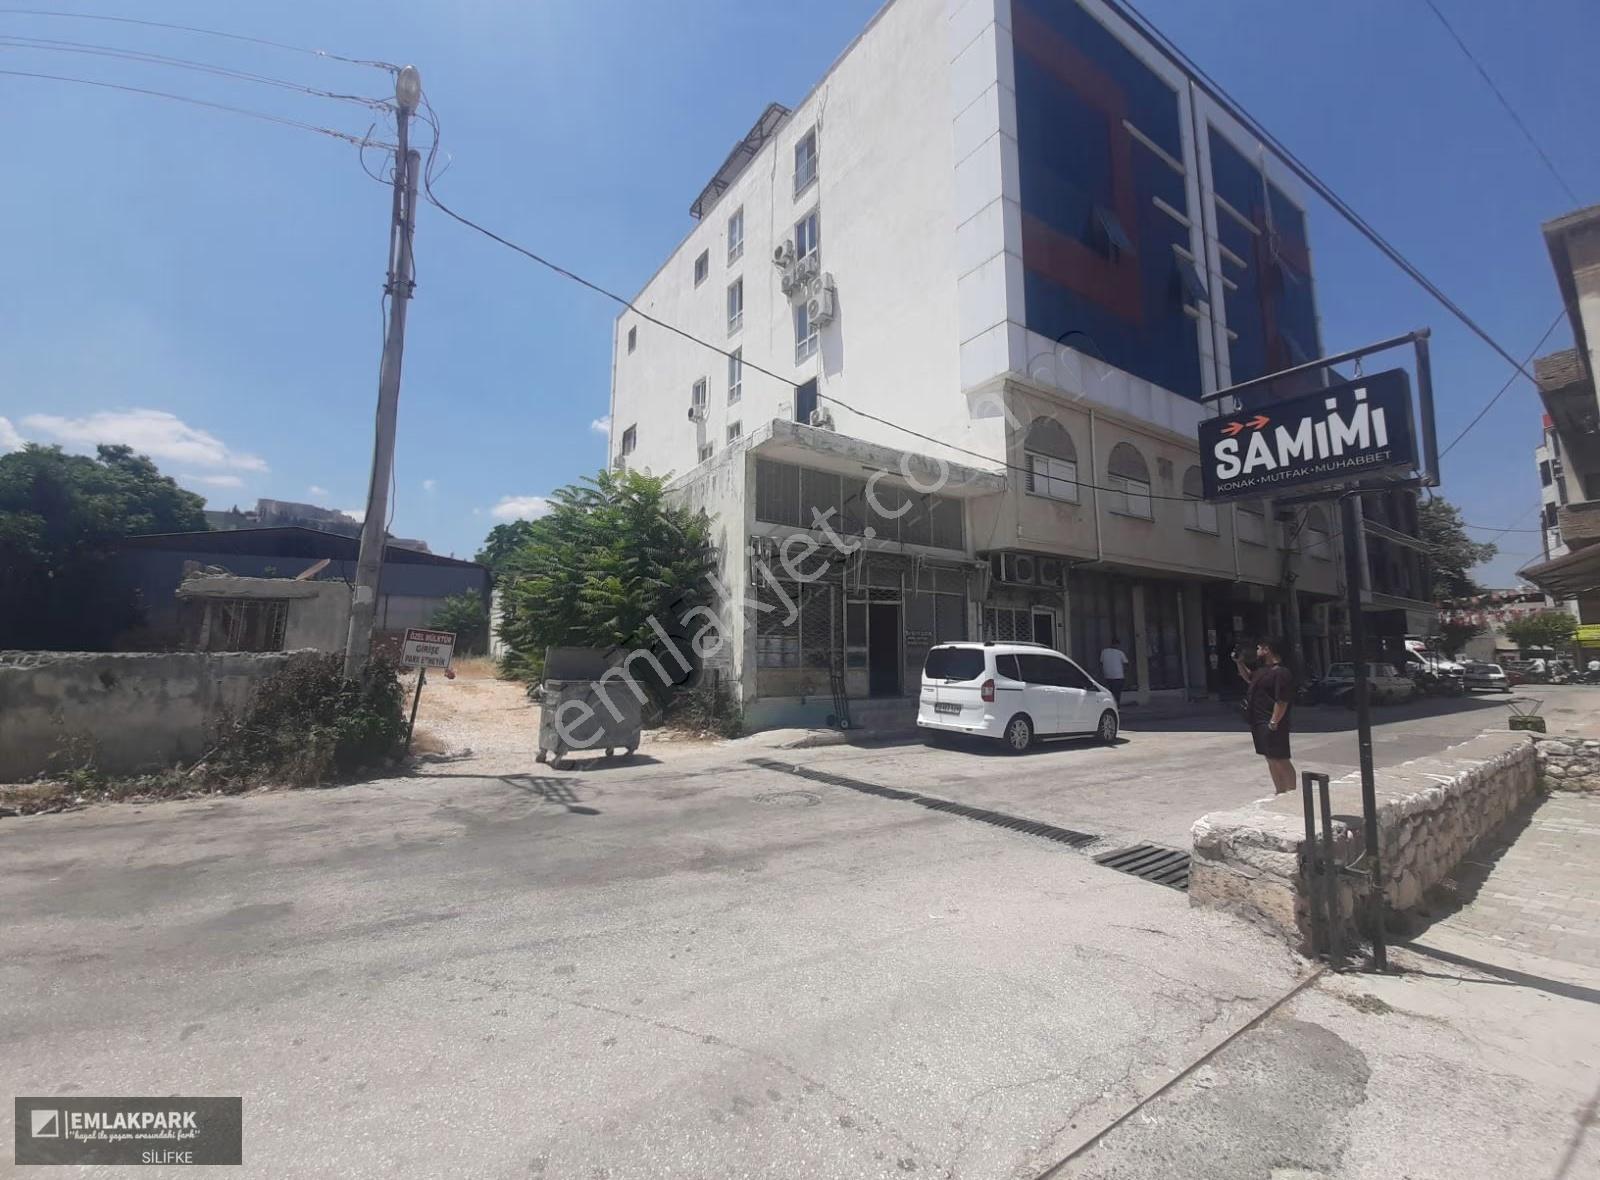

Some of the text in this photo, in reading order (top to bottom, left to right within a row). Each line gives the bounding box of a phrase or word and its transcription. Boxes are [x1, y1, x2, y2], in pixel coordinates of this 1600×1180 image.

[1217, 450, 1392, 492] KONAK MUTFAK MUHABBET
